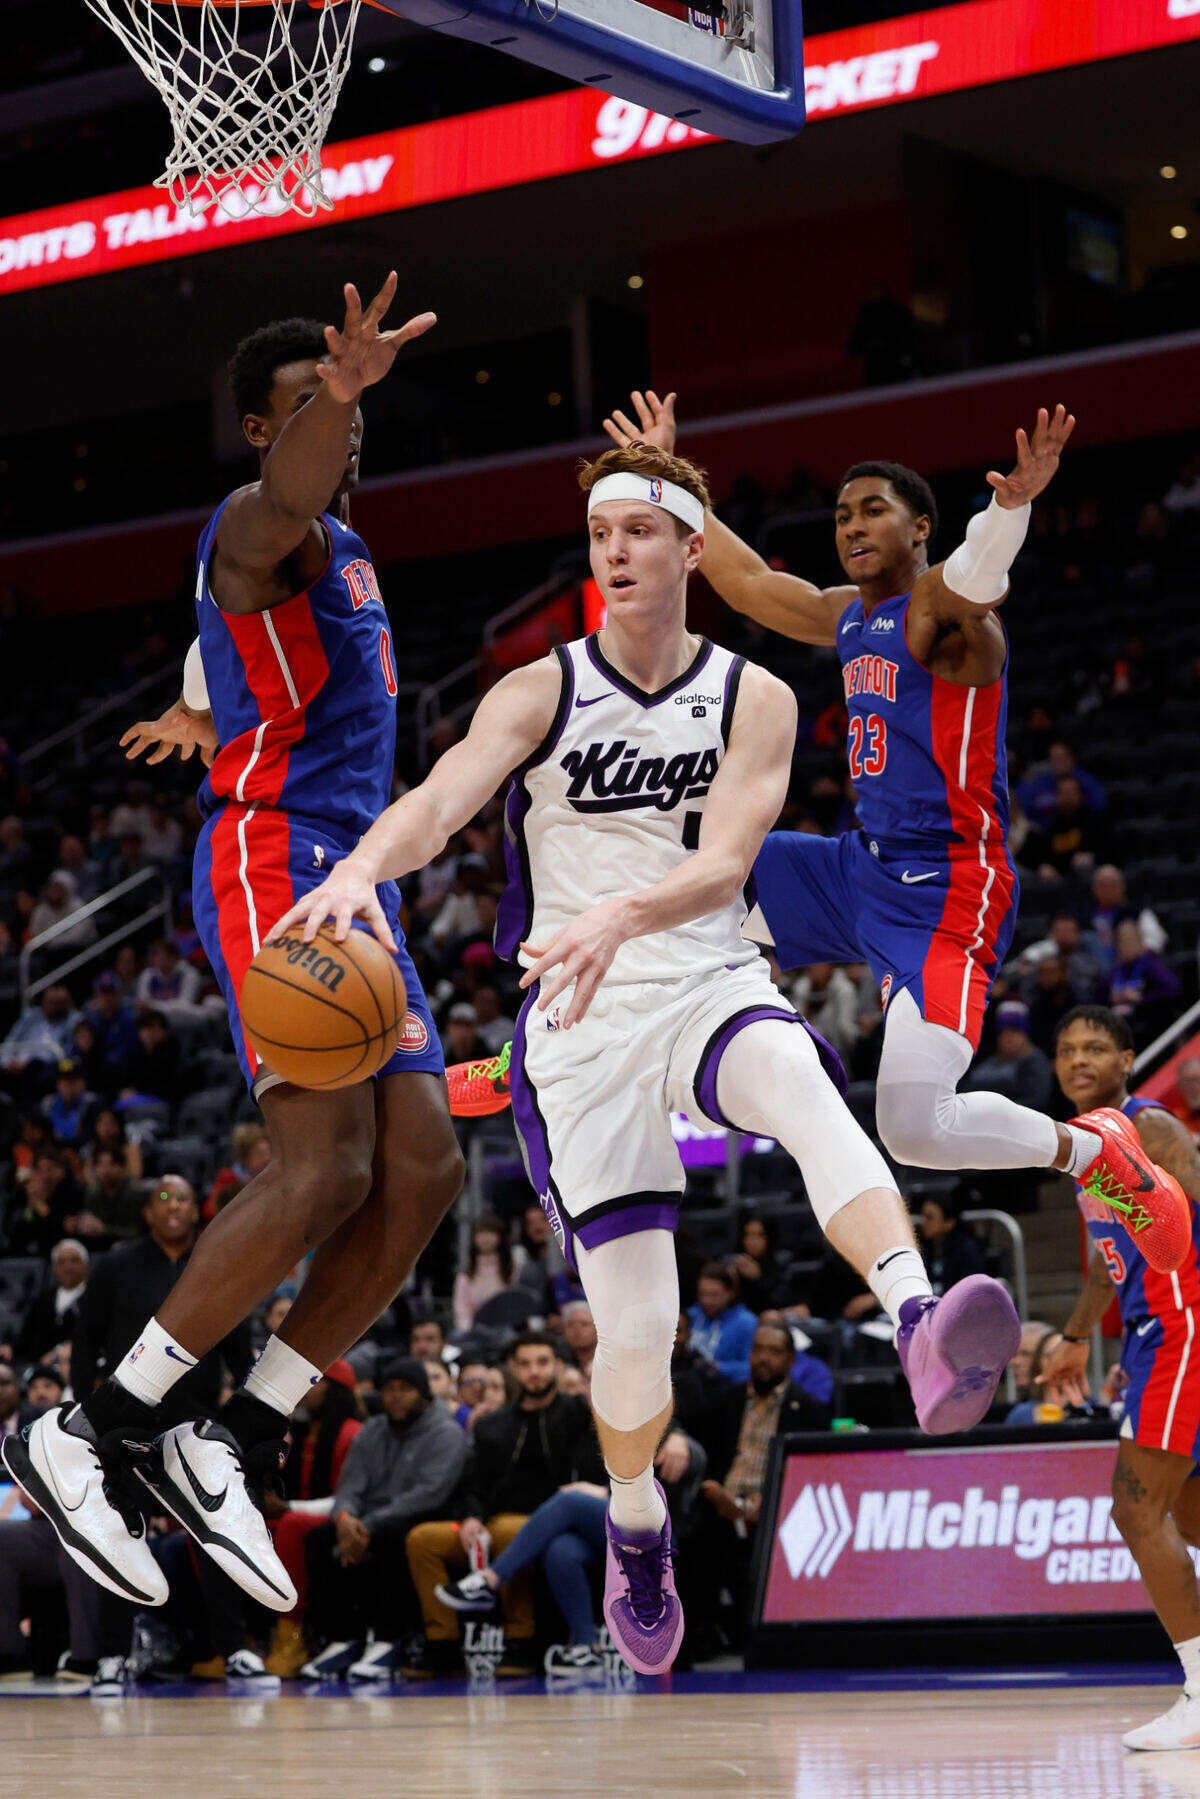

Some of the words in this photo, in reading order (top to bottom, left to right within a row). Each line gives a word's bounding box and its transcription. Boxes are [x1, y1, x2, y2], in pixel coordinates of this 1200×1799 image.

[102, 195, 207, 250] TALK
[302, 153, 394, 207] DAY
[380, 627, 396, 696] 0
[842, 654, 899, 704] DETROIT
[674, 693, 722, 706] dialpad
[560, 740, 720, 812] Kings
[848, 713, 887, 779] 23
[265, 936, 346, 994] Wilso
[853, 1485, 1125, 1560] Michigan
